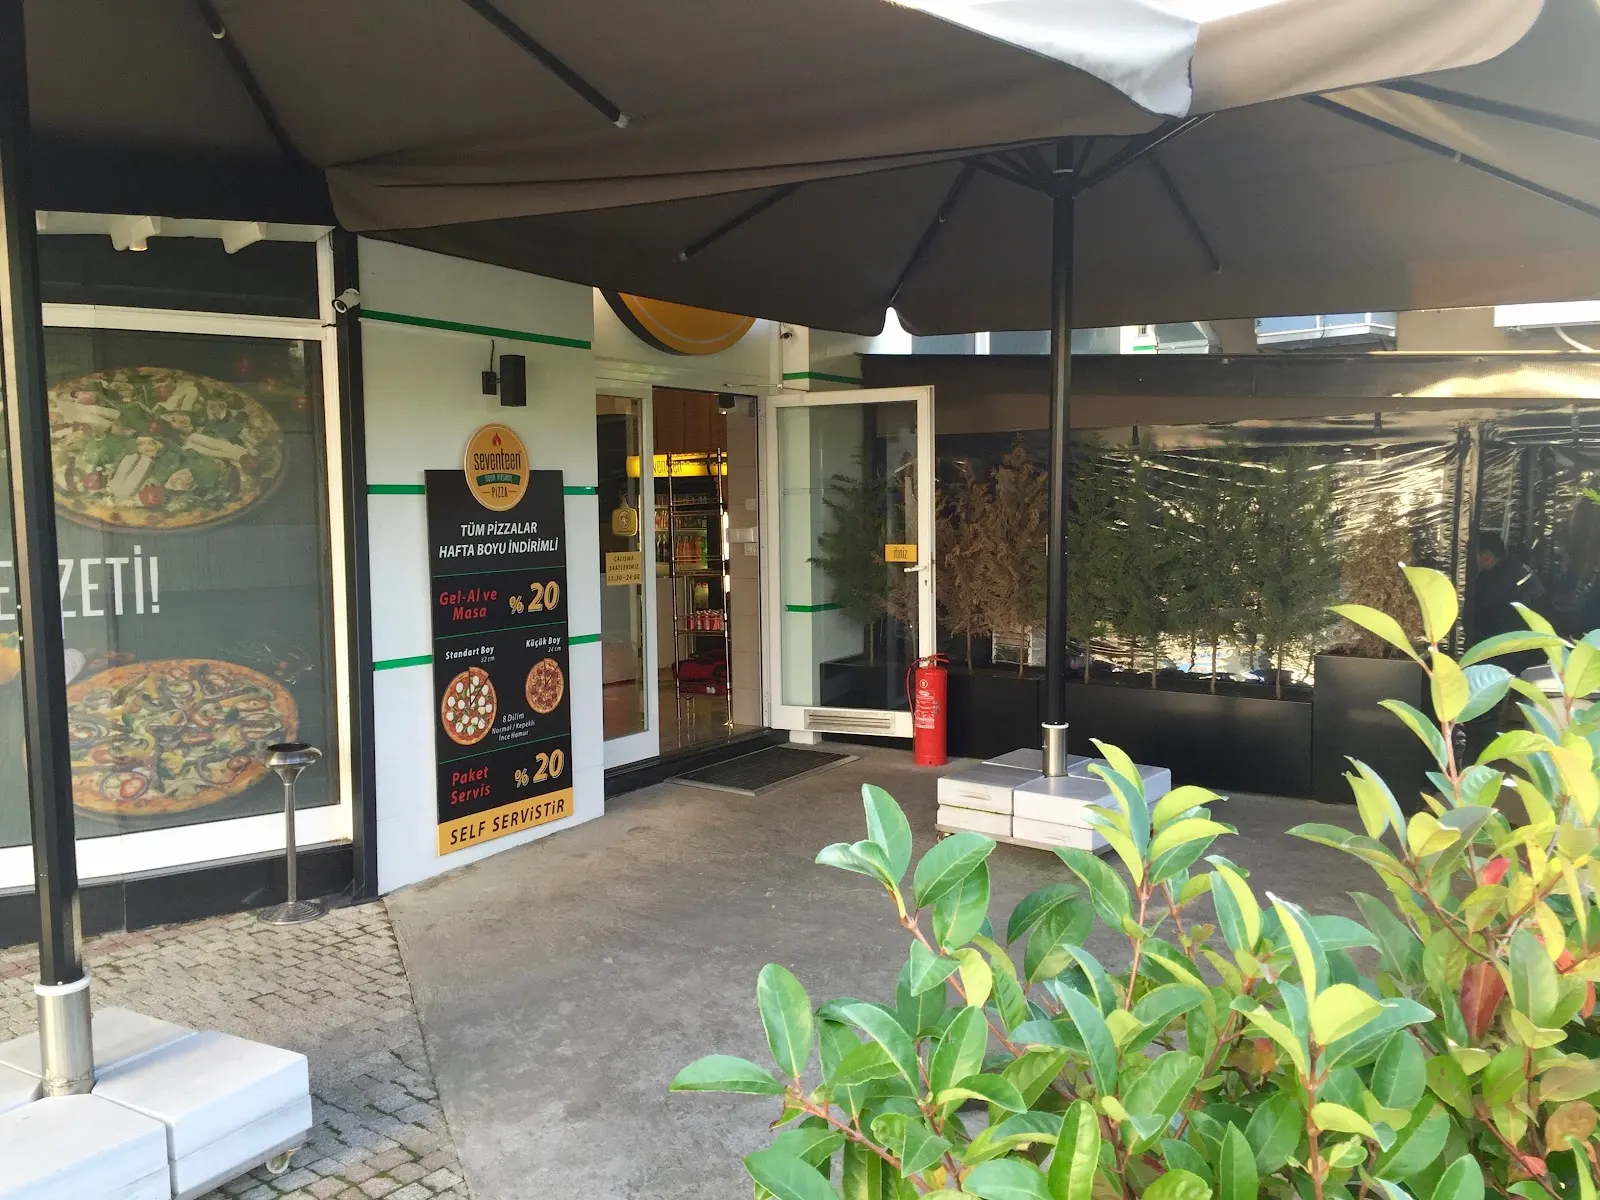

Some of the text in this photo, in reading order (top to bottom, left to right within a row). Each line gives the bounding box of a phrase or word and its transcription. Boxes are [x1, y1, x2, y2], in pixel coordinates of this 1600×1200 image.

[474, 448, 521, 471] seventeen
[460, 520, 538, 537] TÜM PİZZALAR
[438, 537, 559, 559] HAFTA BOYU İNDİRİMLİ
[439, 588, 497, 605] Gel-Al ve
[509, 580, 560, 614] % 20
[452, 606, 487, 621] Masa
[525, 636, 561, 649] Küçük Boy
[445, 644, 495, 661] Standart Boy
[502, 712, 525, 723] 8 Dilim
[492, 724, 512, 735] Normal
[512, 730, 529, 740] Hamur
[452, 765, 489, 787] Paket
[514, 748, 565, 788] % 20
[450, 783, 491, 805] Servis
[450, 820, 486, 845] SELF
